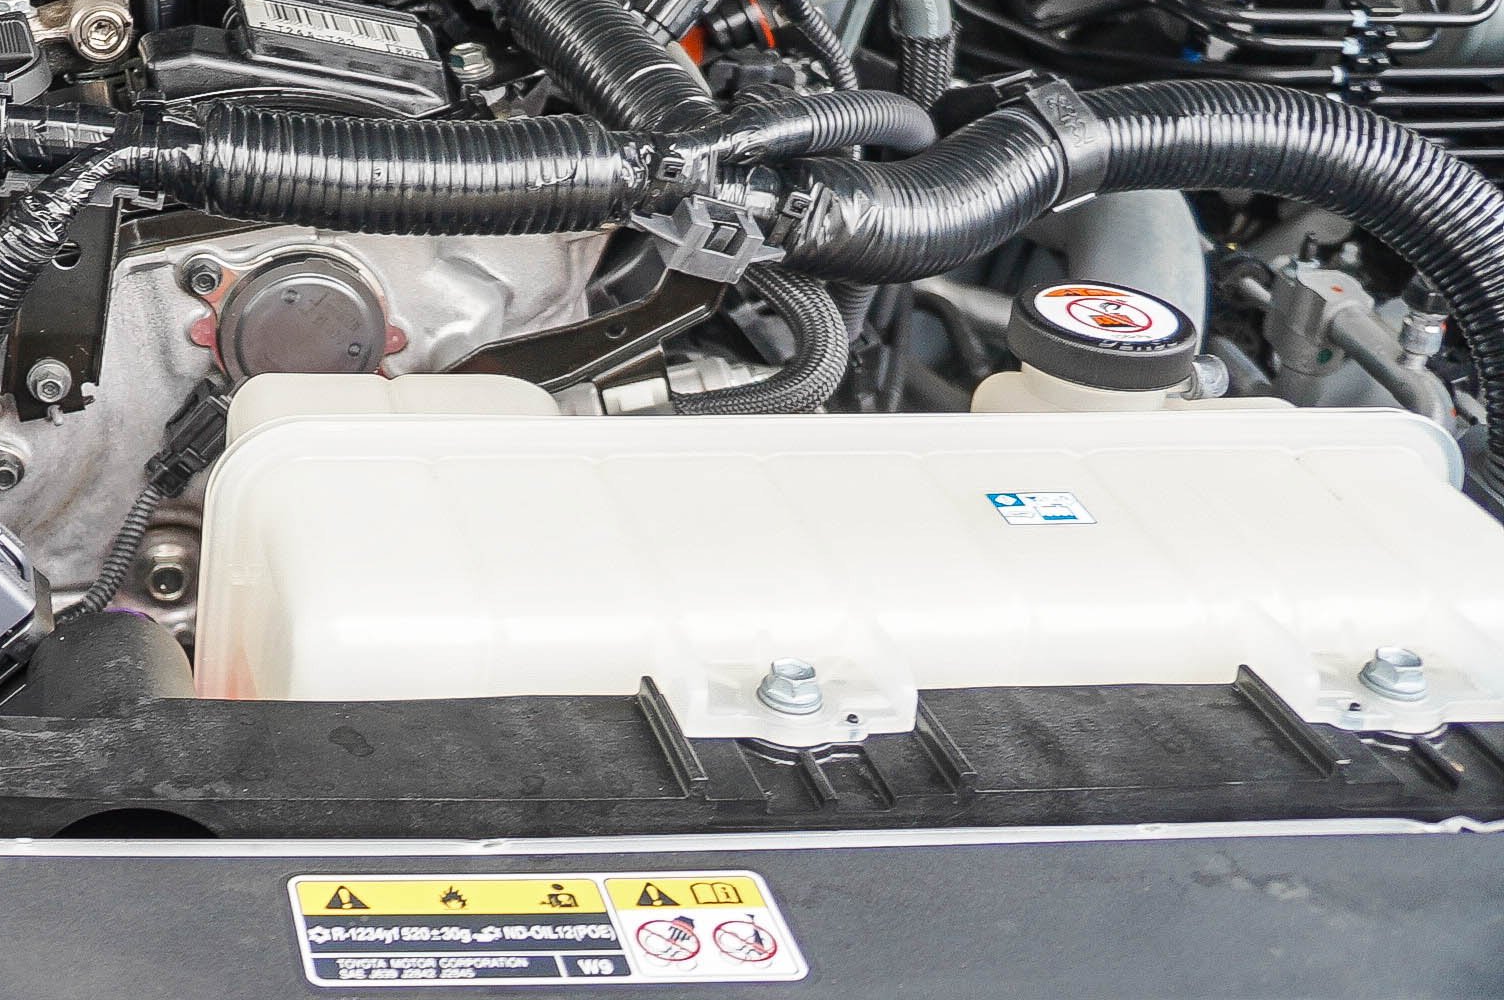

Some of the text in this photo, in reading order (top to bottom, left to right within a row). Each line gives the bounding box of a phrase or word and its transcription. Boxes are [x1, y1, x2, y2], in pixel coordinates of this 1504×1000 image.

[336, 958, 386, 969] TOYOTA
[390, 958, 437, 969] MOTOR
[439, 957, 529, 968] CORPORATION
